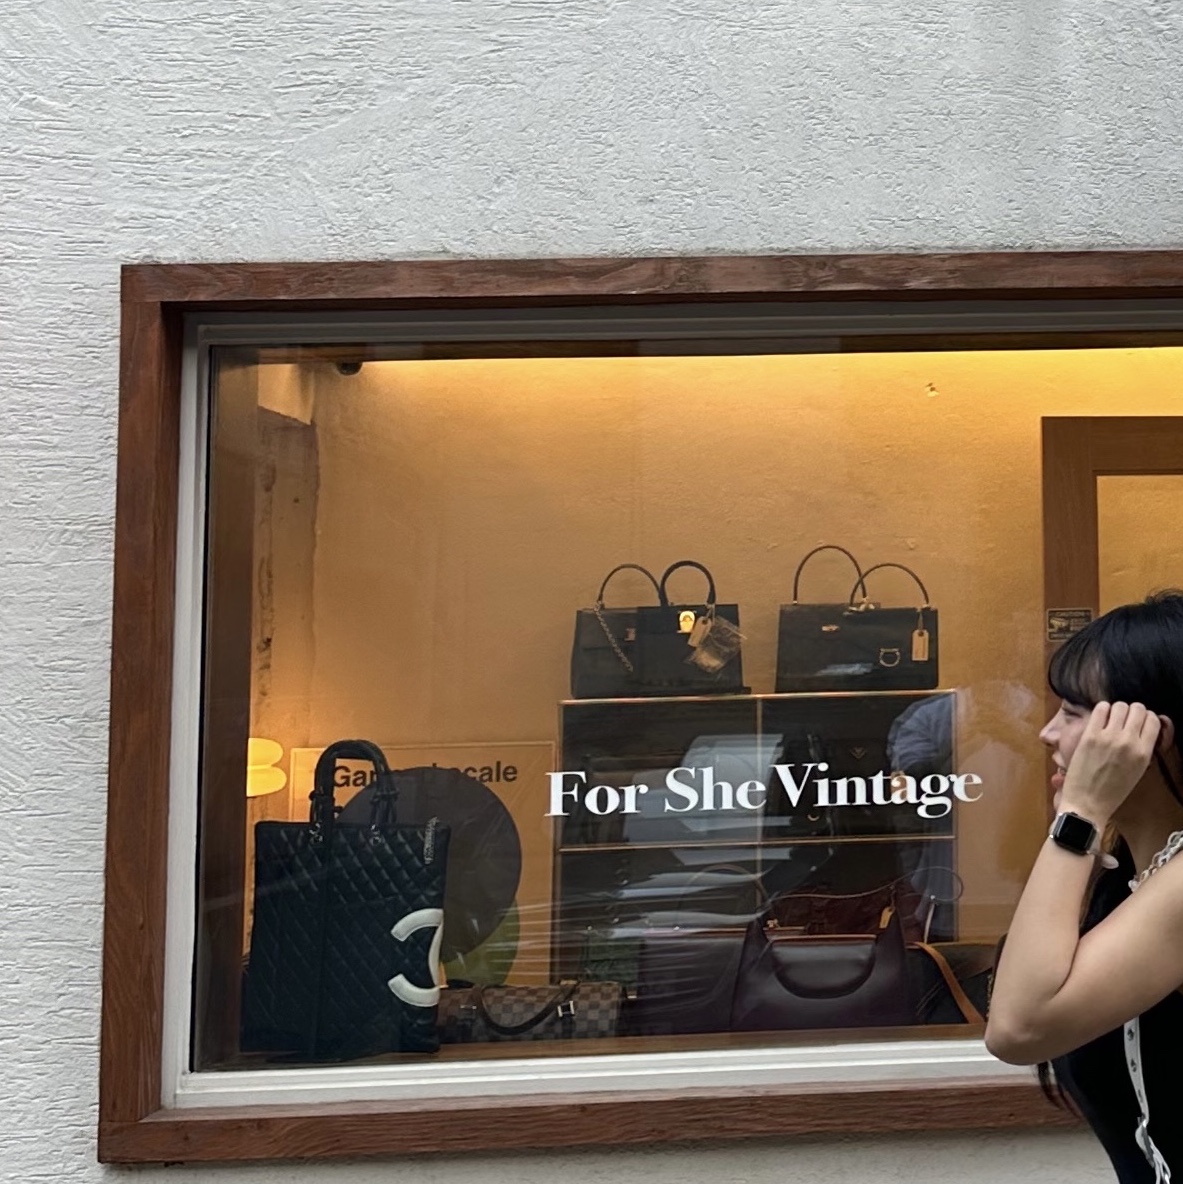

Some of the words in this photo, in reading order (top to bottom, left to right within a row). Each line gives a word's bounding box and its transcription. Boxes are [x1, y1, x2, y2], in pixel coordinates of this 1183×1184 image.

[544, 771, 649, 817] For
[664, 766, 767, 813] She
[770, 762, 984, 819] Vintage
